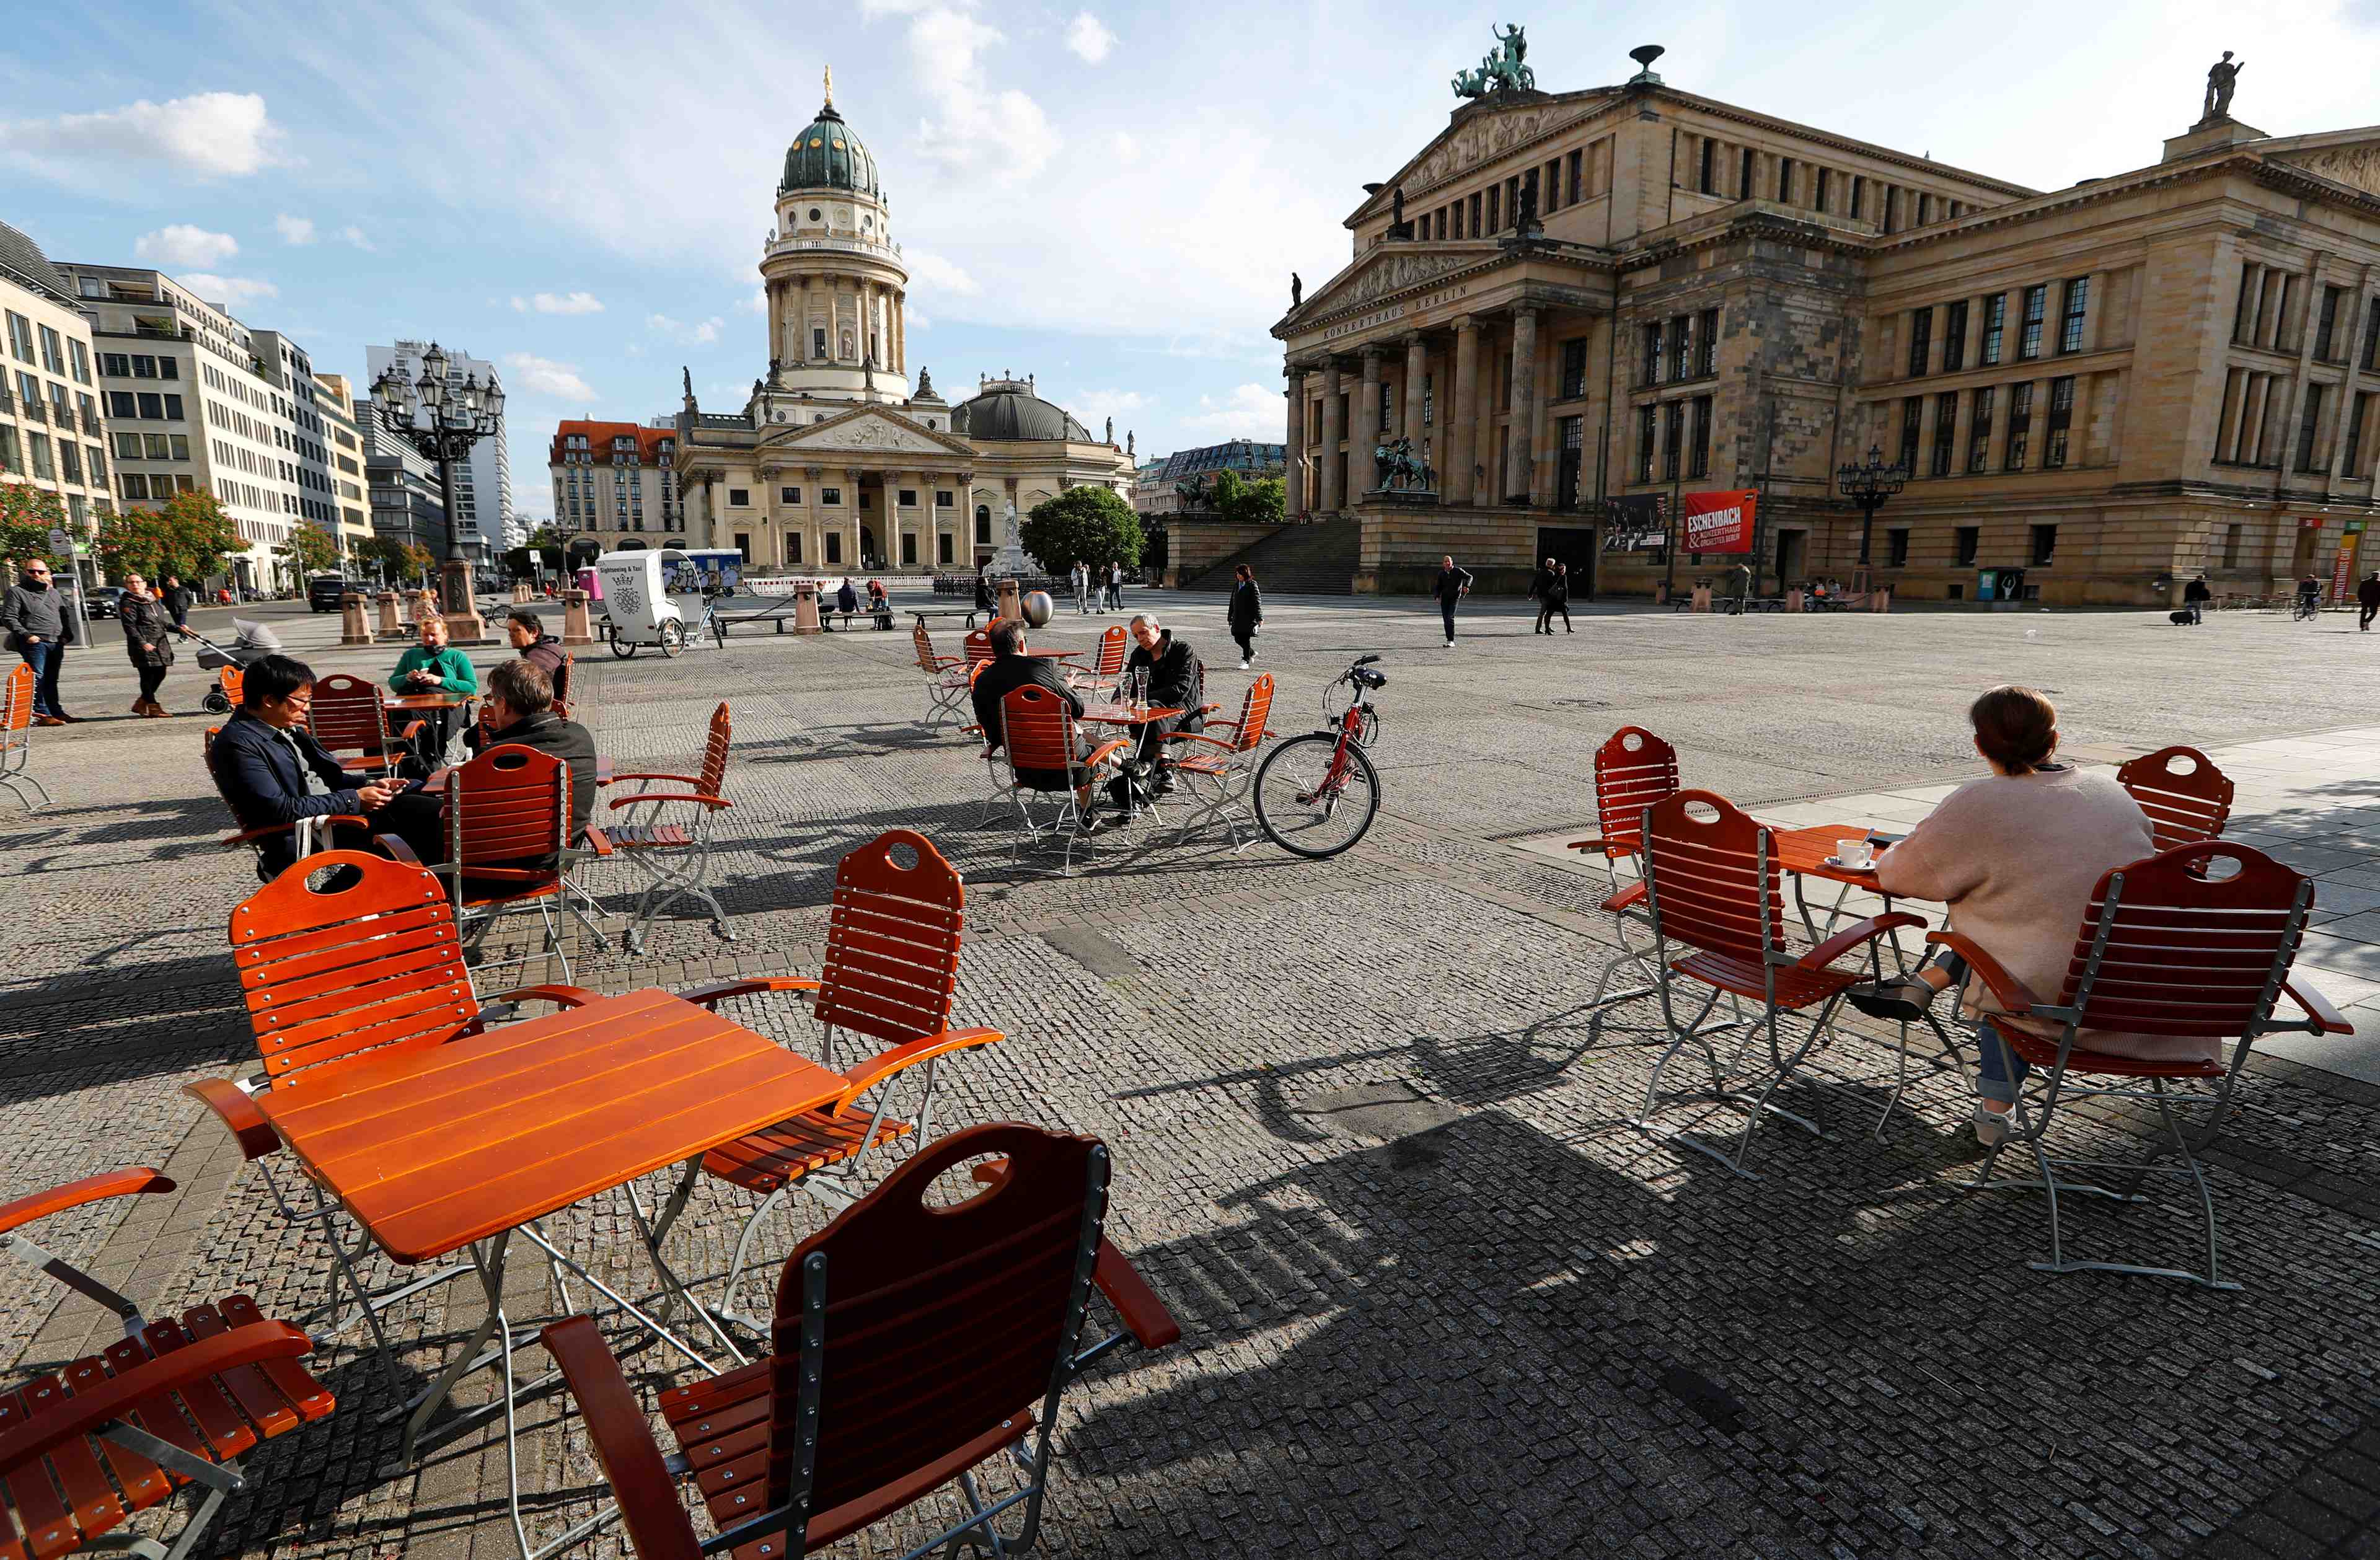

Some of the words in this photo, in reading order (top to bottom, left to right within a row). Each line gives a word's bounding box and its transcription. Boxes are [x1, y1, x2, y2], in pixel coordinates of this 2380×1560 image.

[1323, 306, 1405, 340] KONZERTHAUS
[1416, 284, 1468, 310] BERLIN
[1688, 506, 1741, 533] ESCHENBACH
[1688, 533, 1701, 549] &
[1700, 524, 1741, 539] KONZERTHAUS
[1726, 533, 1740, 543] BERLIN
[600, 566, 627, 574] Sightseeing
[2332, 561, 2350, 599] KONZERTHAUS
